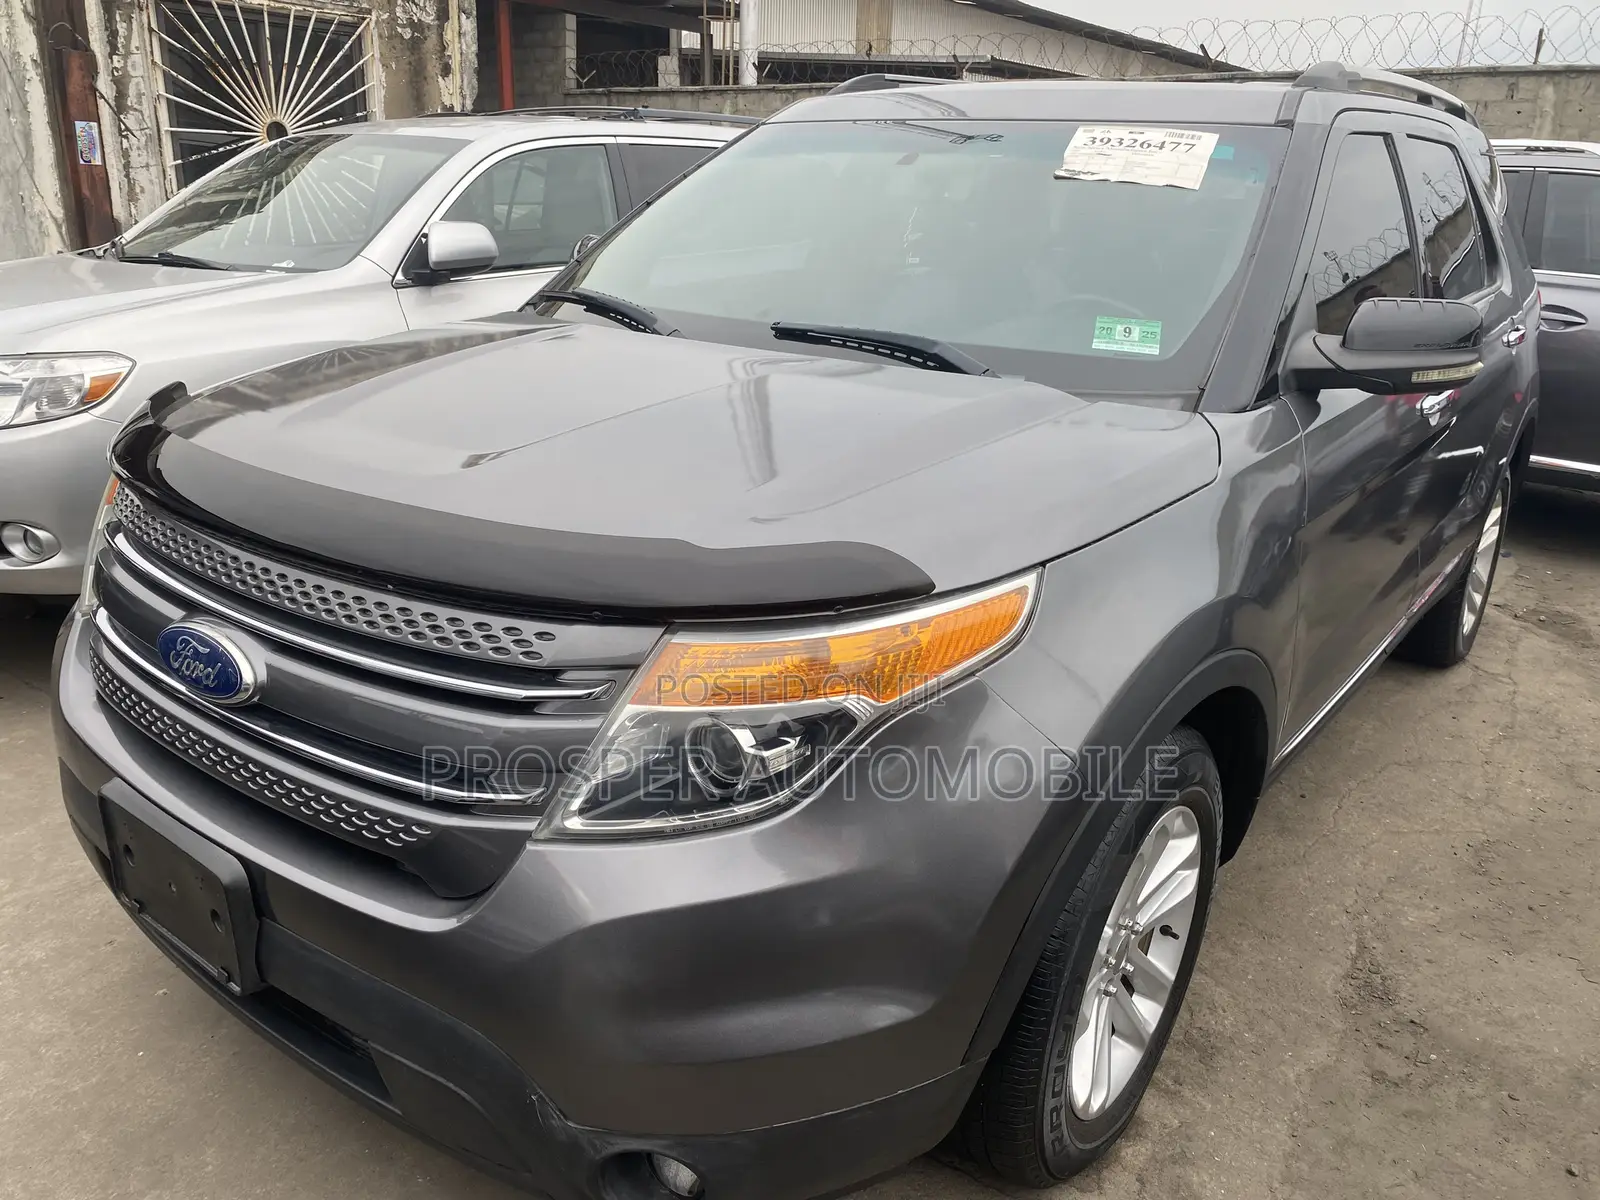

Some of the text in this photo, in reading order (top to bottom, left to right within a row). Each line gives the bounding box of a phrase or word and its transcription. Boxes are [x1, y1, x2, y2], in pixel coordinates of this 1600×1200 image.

[1083, 136, 1197, 153] 39326477
[1098, 326, 1157, 339] 20 9 25
[170, 635, 222, 687] Ford
